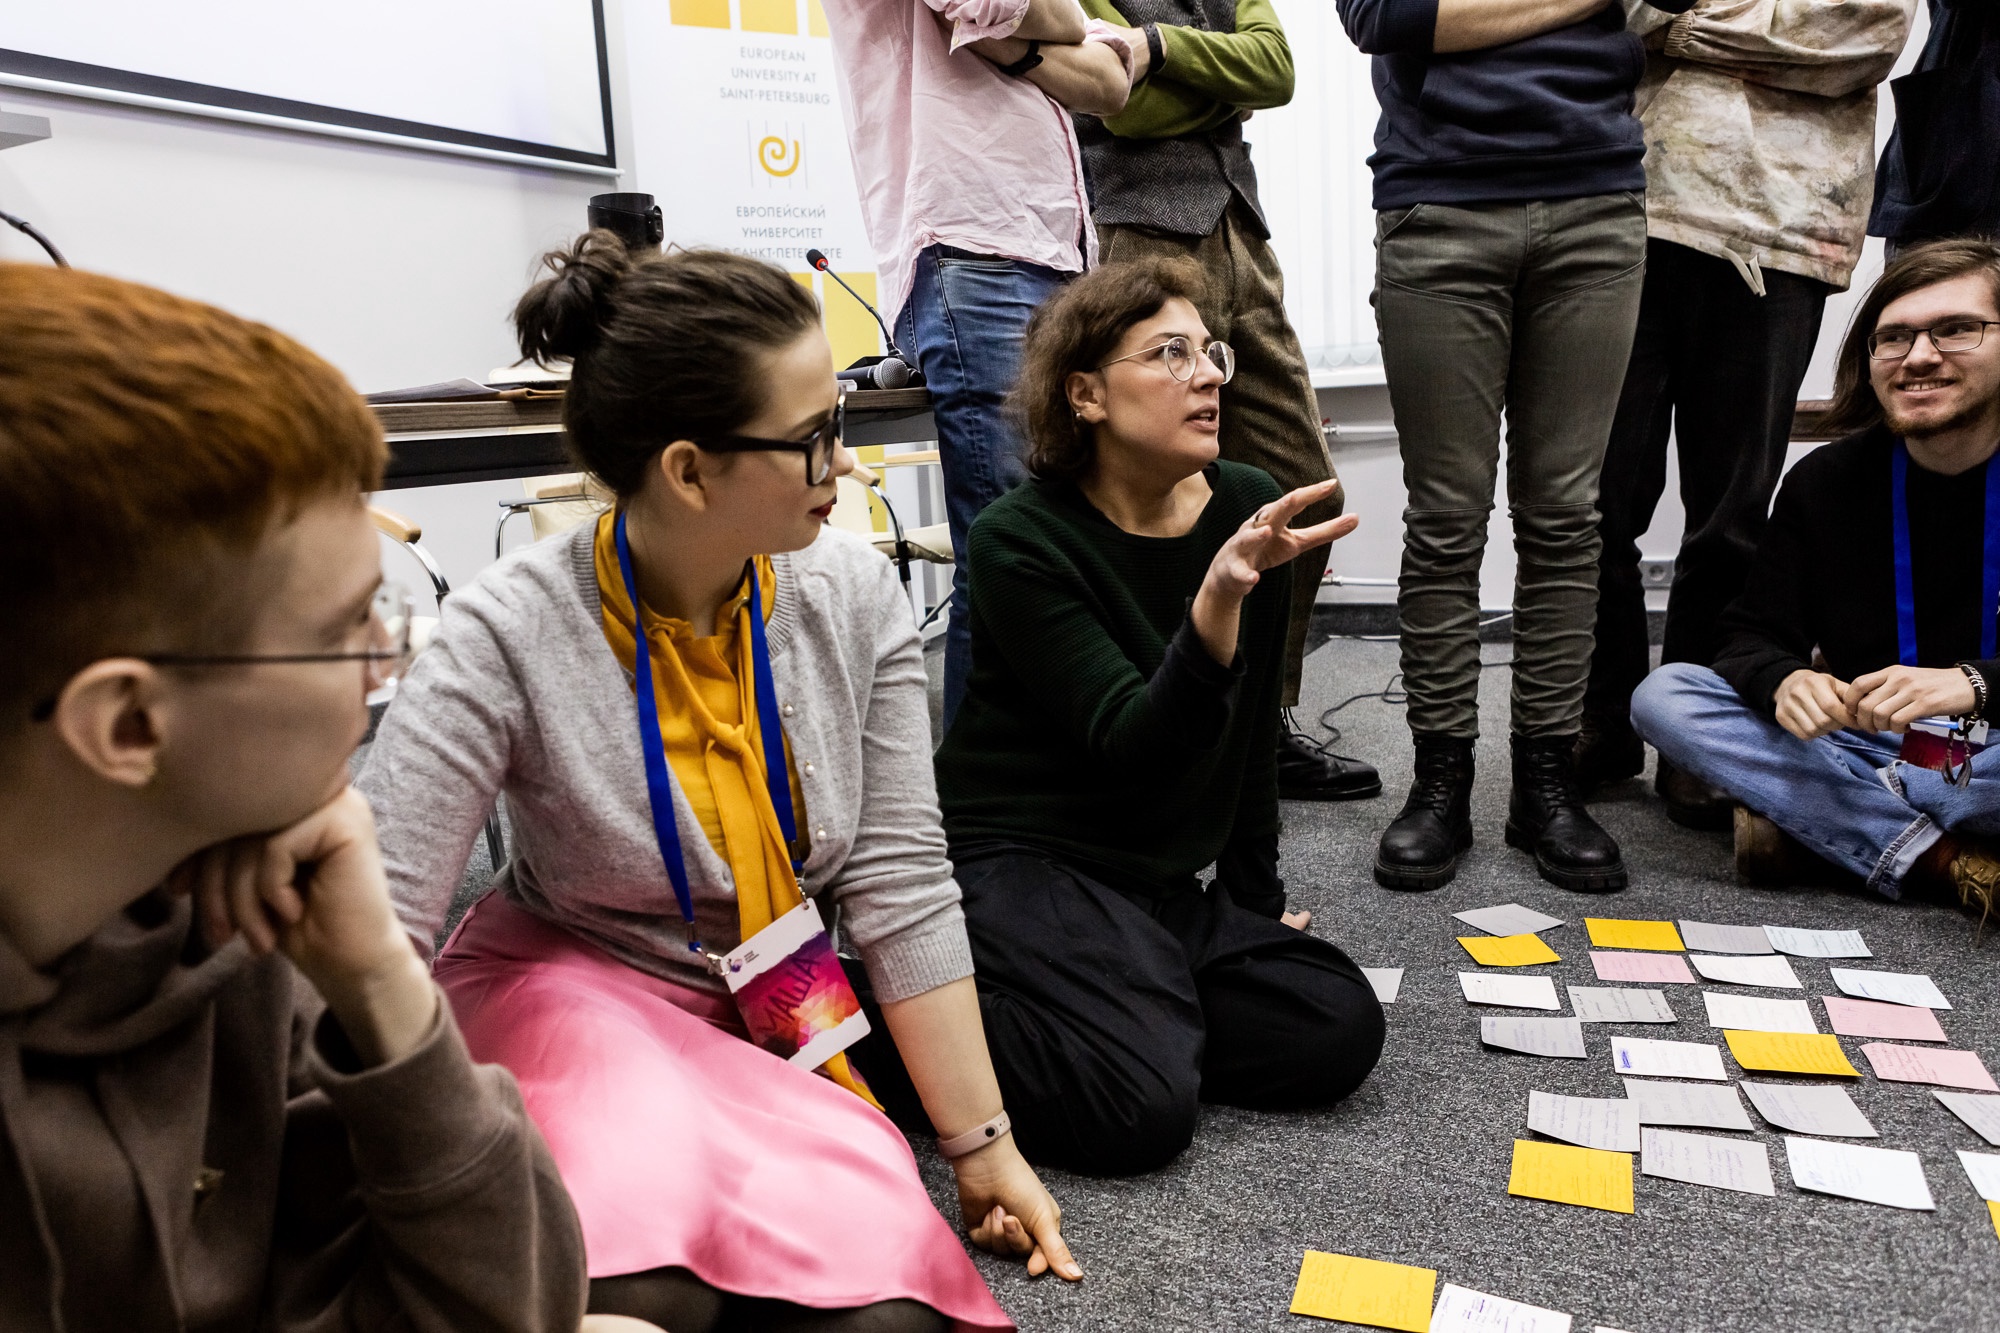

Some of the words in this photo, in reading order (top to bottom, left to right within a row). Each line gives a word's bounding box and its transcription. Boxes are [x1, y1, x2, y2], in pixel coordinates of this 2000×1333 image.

[740, 46, 806, 62] EUROPEAN
[731, 67, 800, 82] UNIVERSITY
[803, 72, 817, 84] AT
[736, 203, 826, 219] ЕВРОПЕЙСКИЙ
[742, 226, 823, 239] УНИВЕРСИТЕТ
